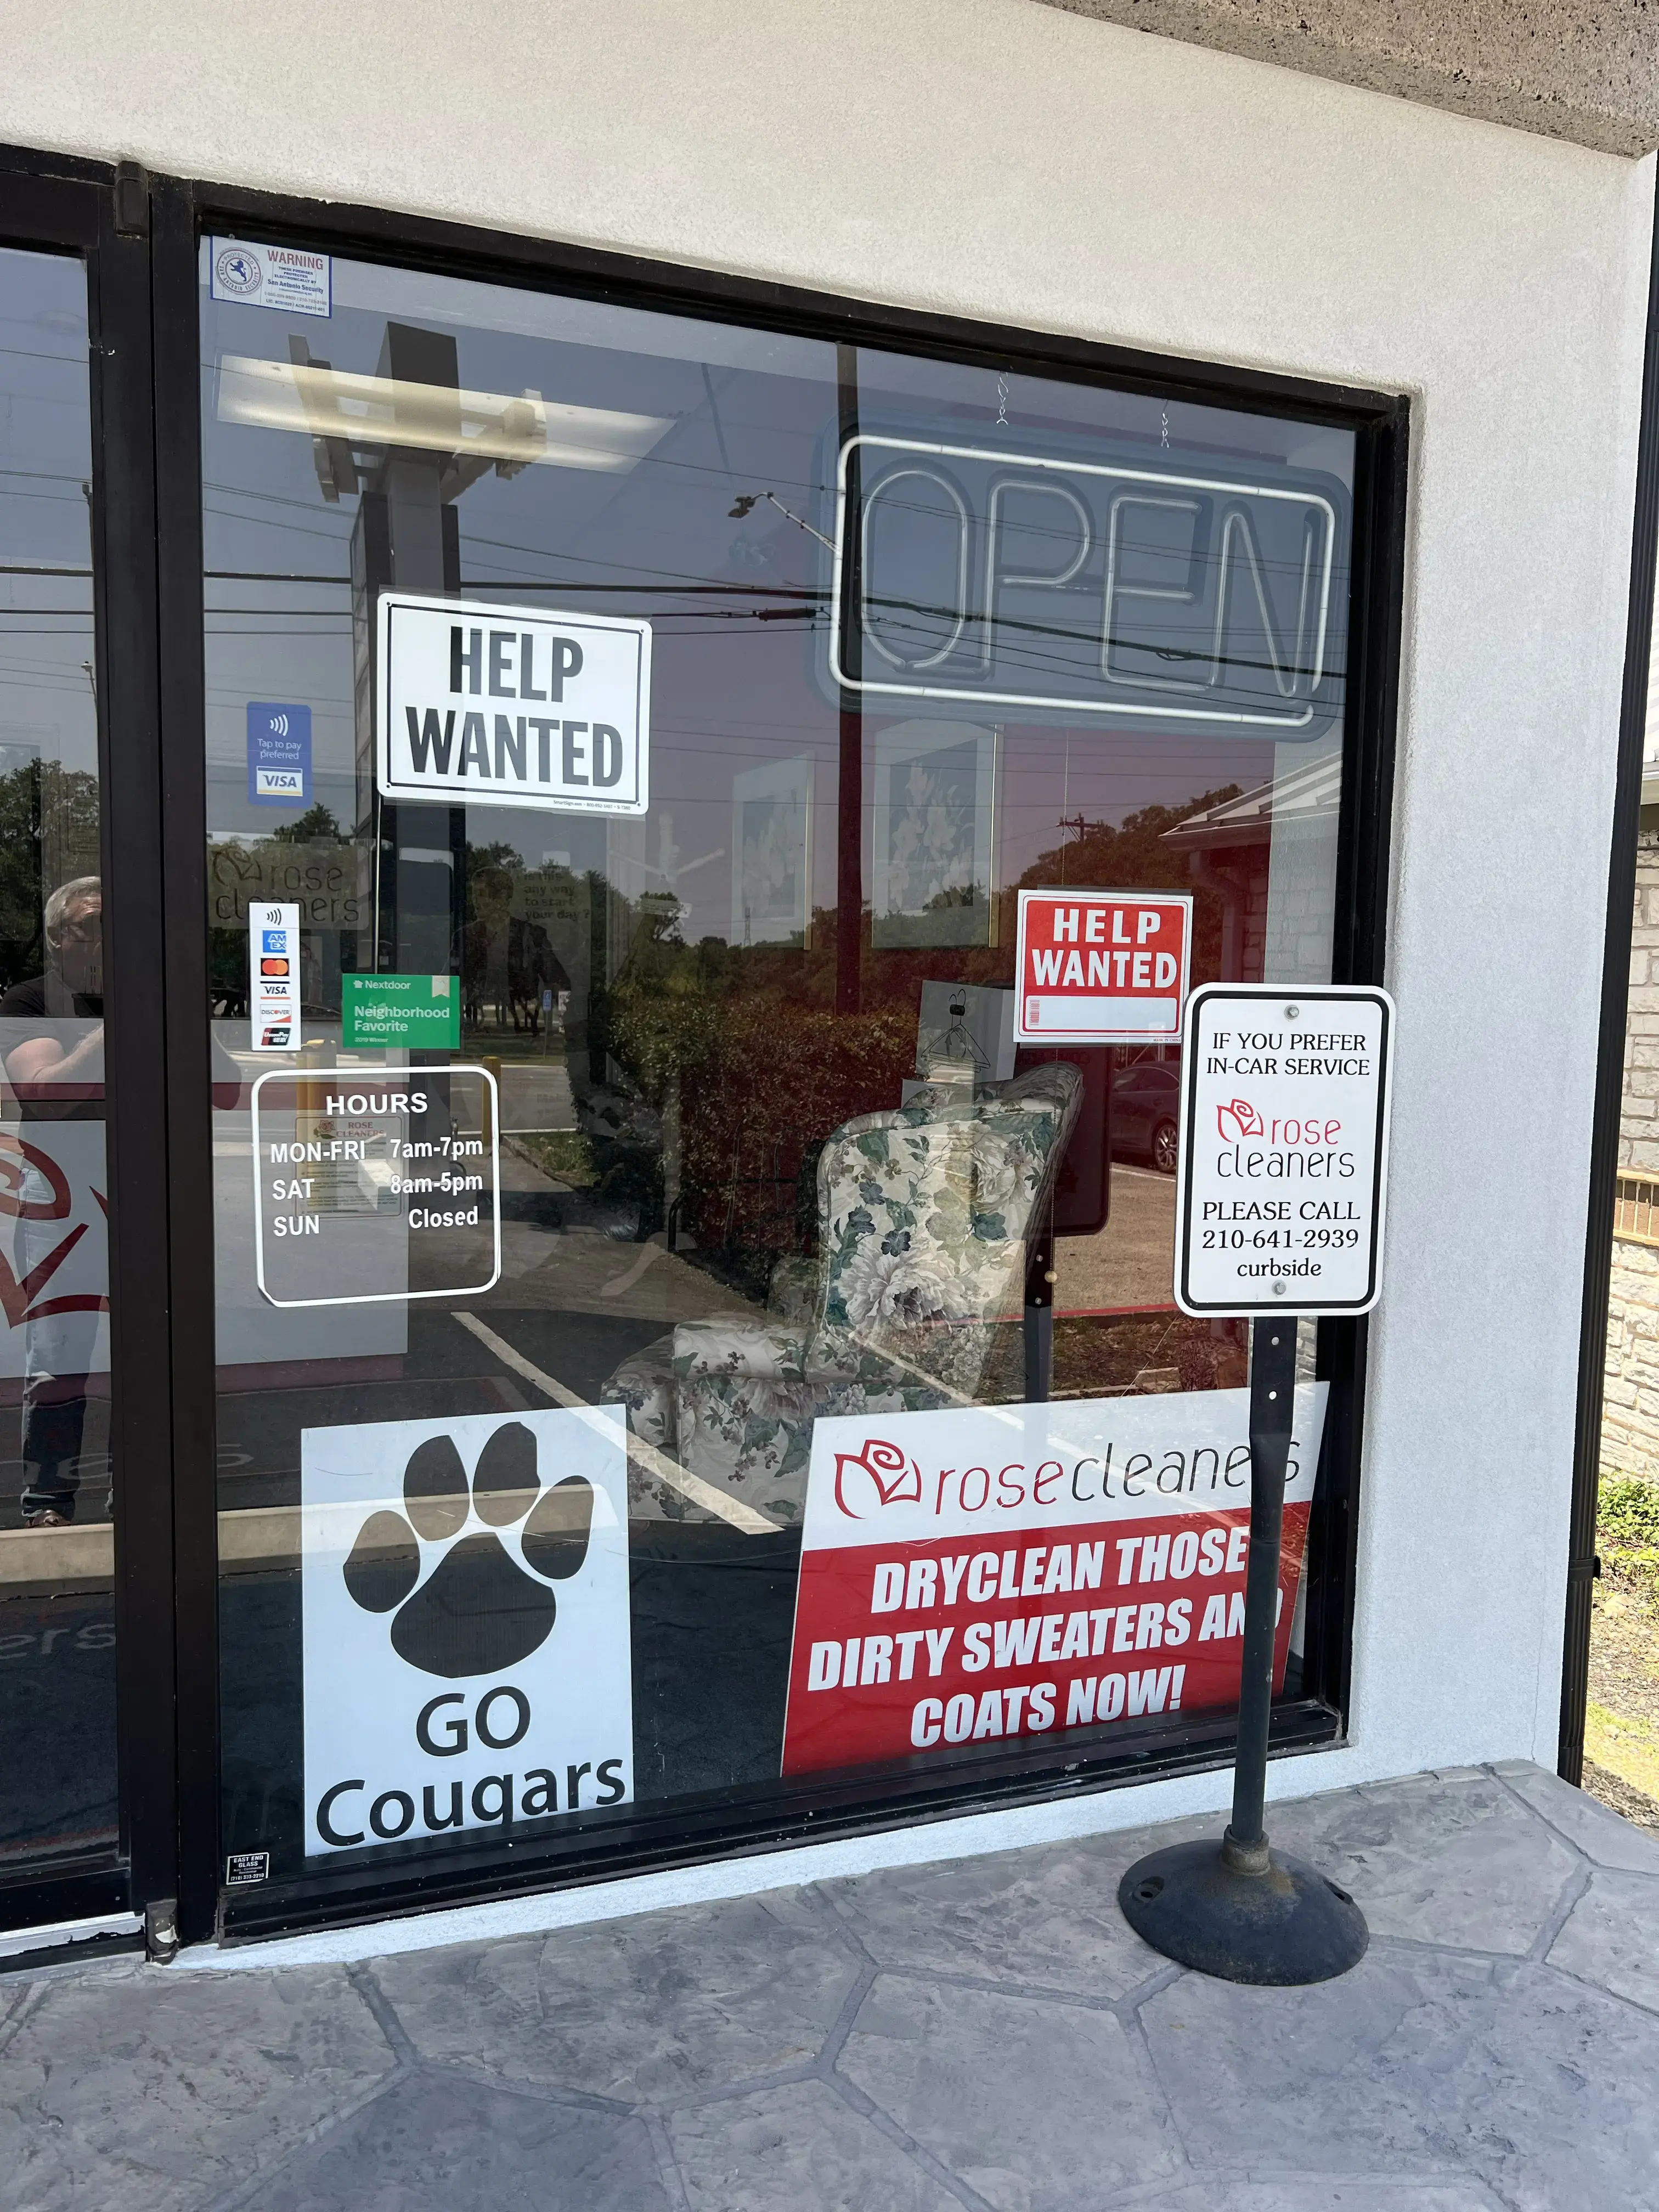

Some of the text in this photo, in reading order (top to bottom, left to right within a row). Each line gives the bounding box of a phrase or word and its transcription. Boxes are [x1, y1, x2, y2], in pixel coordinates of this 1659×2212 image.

[224, 252, 254, 264] PROTECTED
[267, 250, 323, 270] WARNING
[279, 281, 301, 289] Antonio
[301, 285, 324, 294] Security
[861, 469, 1313, 702] OPEN
[450, 625, 584, 703] HELP
[257, 738, 273, 749] Tap
[286, 742, 302, 751] pay
[260, 749, 299, 760] preferred
[405, 706, 623, 787] WANTED
[263, 774, 297, 788] VISA
[270, 864, 343, 891] rose
[523, 885, 575, 896] any way
[216, 888, 359, 922] clners
[524, 896, 575, 906] to start
[524, 910, 554, 921] your
[1053, 908, 1161, 944] HELP
[268, 934, 286, 943] AM
[1031, 949, 1177, 988] WANTED
[263, 986, 287, 994] VISA
[365, 980, 411, 990] Nextdoor
[354, 1006, 450, 1020] Neighborhood
[354, 1020, 409, 1031] Favorite
[1212, 1032, 1367, 1051] IF YOU PREFER
[1207, 1058, 1370, 1076] IN-CAR SERVICE
[326, 1092, 428, 1115] HOURS
[1271, 1119, 1341, 1145] rose
[270, 1139, 366, 1164] MON-FRI
[390, 1137, 483, 1160] 7am-7pm
[1217, 1144, 1355, 1178] cleaners
[272, 1178, 315, 1200] SAT
[390, 1171, 483, 1195] 8am-5pm
[1203, 1201, 1361, 1221] PLEASE CALL
[273, 1206, 479, 1237] SUN Closed
[1202, 1229, 1359, 1249] 210-641-2939
[1237, 1258, 1322, 1277] curbside
[871, 1525, 1250, 1614] DRYCLEAN THOSE
[806, 1587, 1284, 1692] DIRTY SWEATERS AN
[910, 1664, 1187, 1747] COATS NOW!
[416, 1685, 531, 1757] GO
[316, 1758, 626, 1847] Cougars
